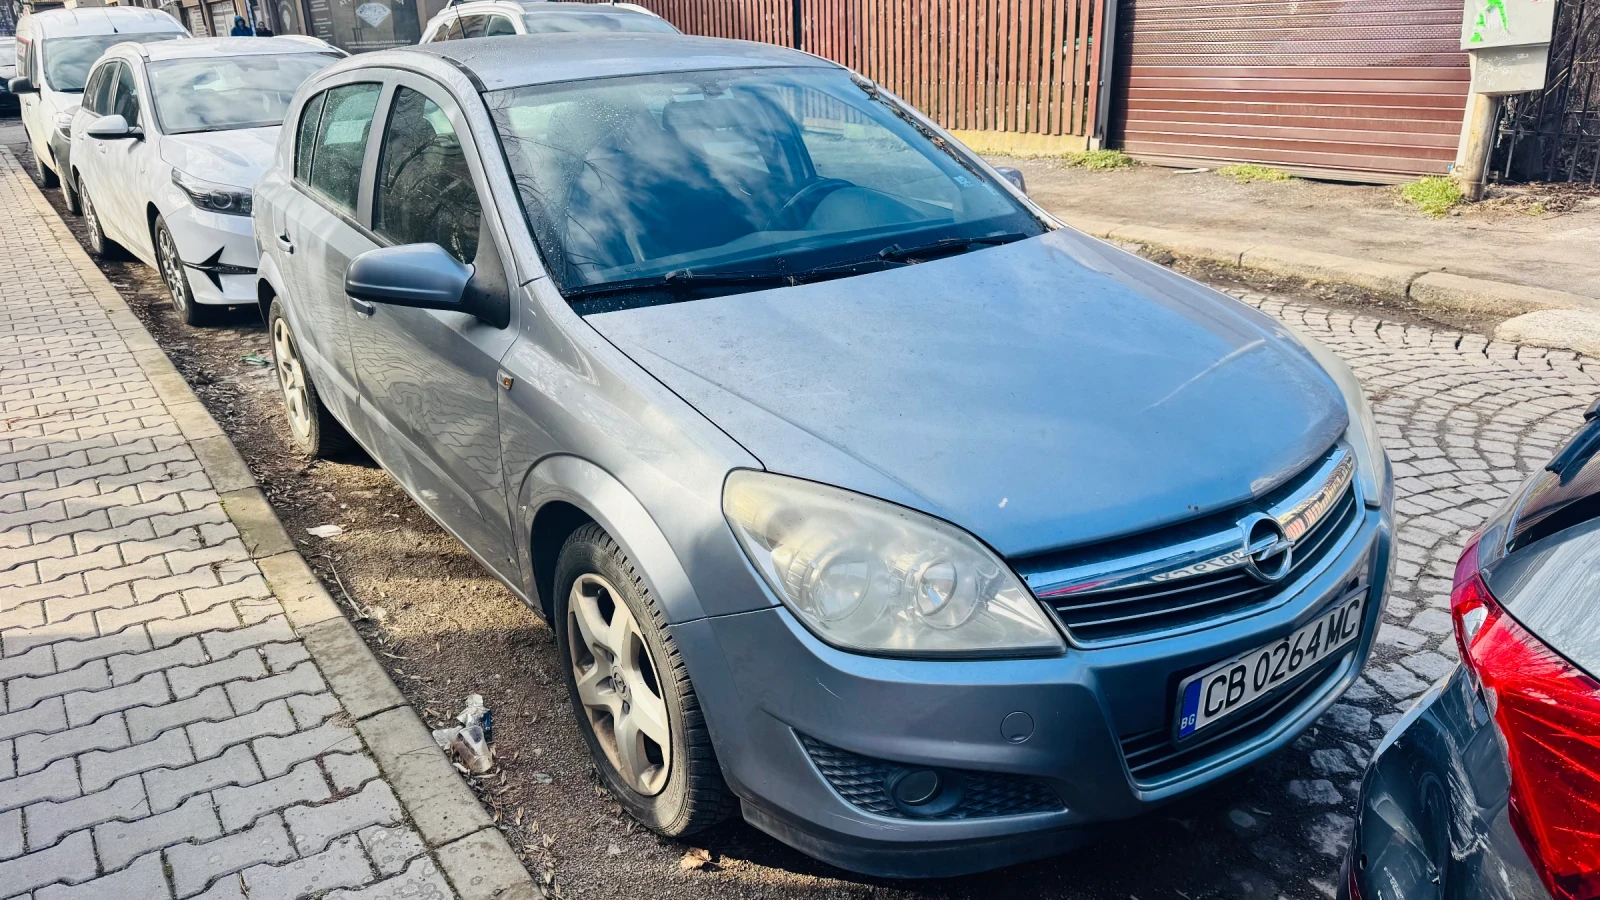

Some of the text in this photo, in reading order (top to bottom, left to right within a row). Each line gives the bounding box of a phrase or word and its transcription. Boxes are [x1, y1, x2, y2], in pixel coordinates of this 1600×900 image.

[1203, 599, 1360, 718] CB 0264 MC
[1180, 713, 1196, 730] BG
